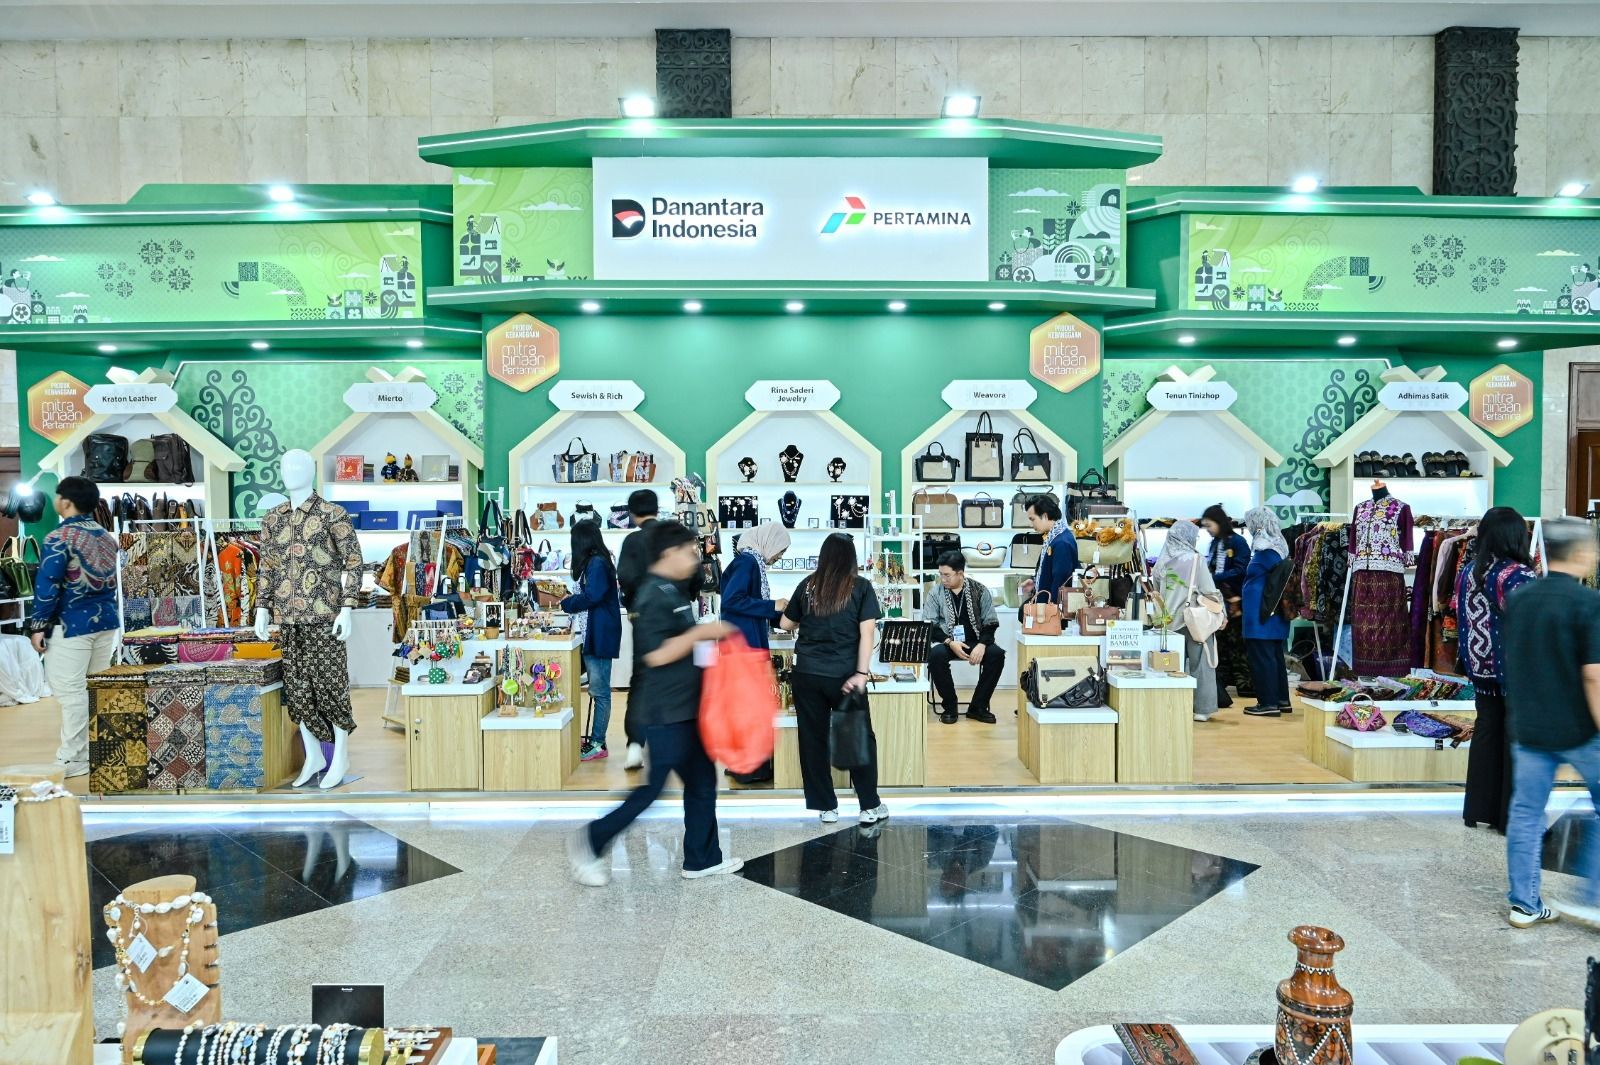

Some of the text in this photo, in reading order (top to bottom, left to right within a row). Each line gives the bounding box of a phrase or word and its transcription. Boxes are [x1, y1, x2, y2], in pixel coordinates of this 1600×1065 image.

[652, 197, 764, 216] Danantara
[873, 212, 972, 225] PERTAMINA
[652, 219, 757, 238] Indonesia
[502, 341, 537, 355] mitra
[1043, 341, 1079, 356] mitra
[502, 354, 546, 367] binaan
[1043, 354, 1087, 367] binaan
[502, 365, 546, 375] Pertamina
[1043, 365, 1087, 375] Pertamina
[771, 386, 814, 394] Rina Saderi
[973, 391, 1006, 399] Weavora
[128, 394, 157, 402] Leather
[377, 394, 403, 402] Mierto
[599, 392, 605, 400] &
[606, 392, 623, 400] Rich
[777, 395, 807, 404] Jewelry
[1188, 392, 1220, 400] Tinizhop
[1398, 392, 1449, 400] Adhimas Batik
[1482, 391, 1514, 404] mitra
[42, 400, 74, 412] mitra
[1482, 401, 1521, 413] binaan
[42, 409, 83, 421] binaan
[1482, 411, 1521, 421] Pertamina
